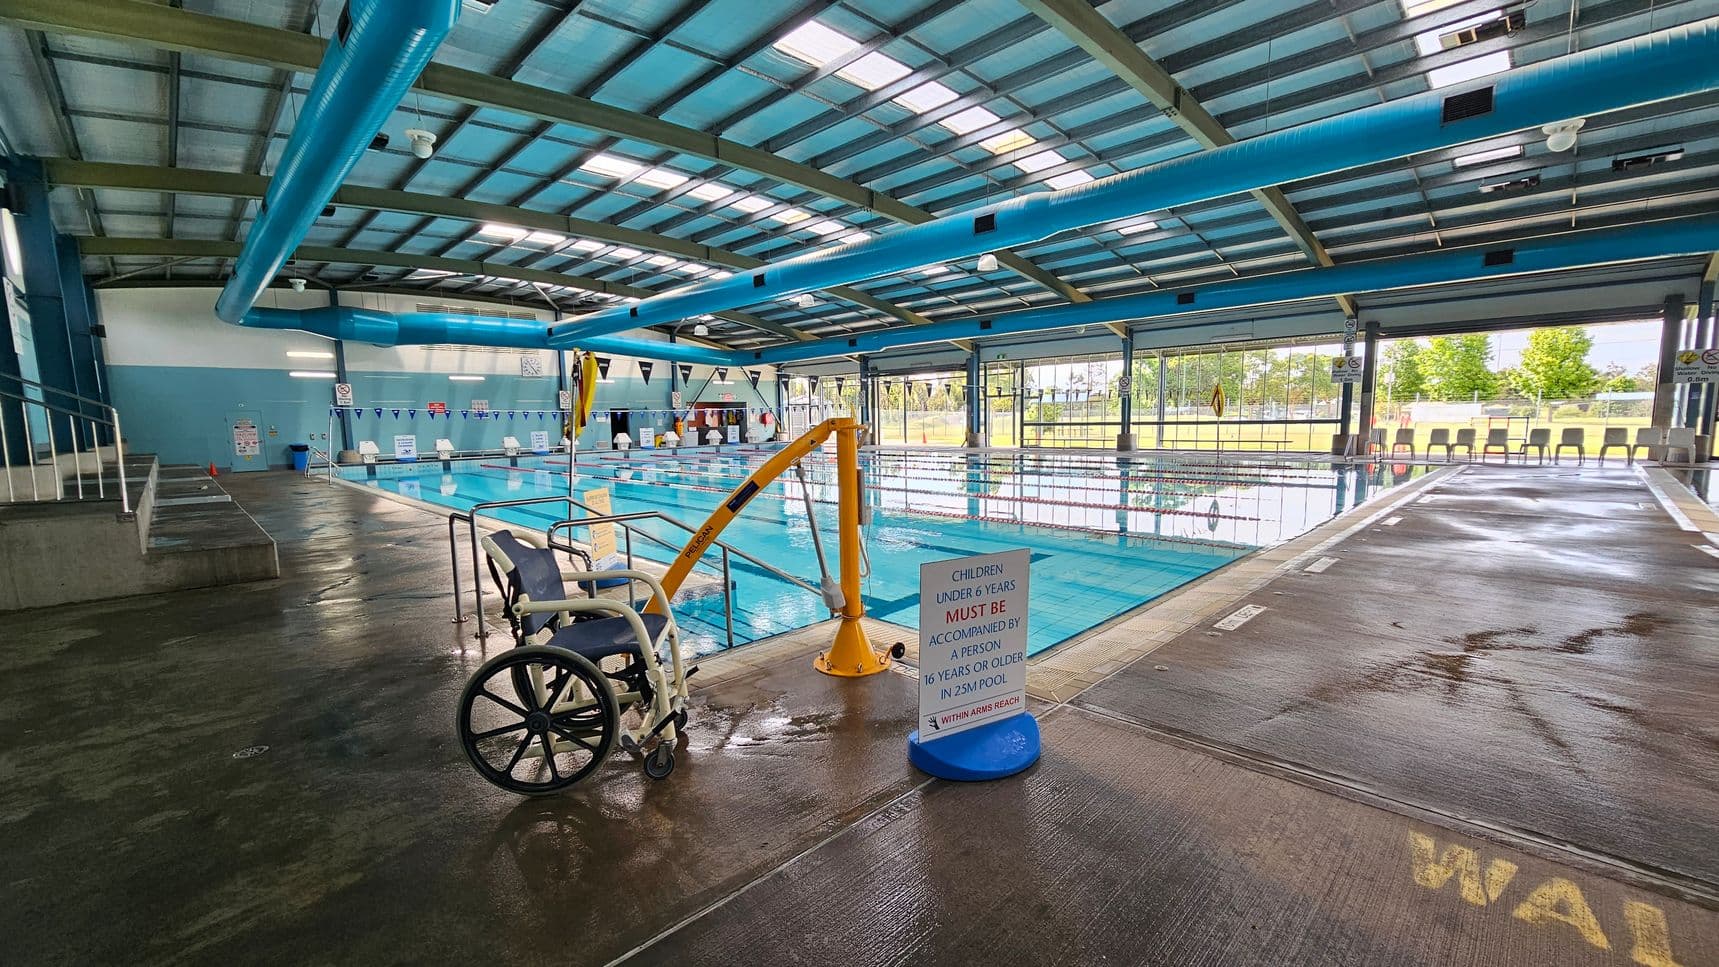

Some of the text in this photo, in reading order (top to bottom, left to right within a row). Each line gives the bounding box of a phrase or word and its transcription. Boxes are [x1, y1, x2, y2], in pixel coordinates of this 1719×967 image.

[684, 525, 714, 559] PELICAN
[951, 563, 1004, 582] CHILDREN
[936, 579, 1016, 604] UNDER 6 YEARS
[945, 600, 1007, 624] MUST BE
[928, 617, 1021, 647] ACCOMPANIED BY
[950, 640, 1001, 661] A PERSON
[924, 652, 1024, 686] 16 YEARS OR OLDER
[940, 673, 1008, 700] IN 25M POOL
[941, 696, 1020, 725] WITHIN ARMS REACH
